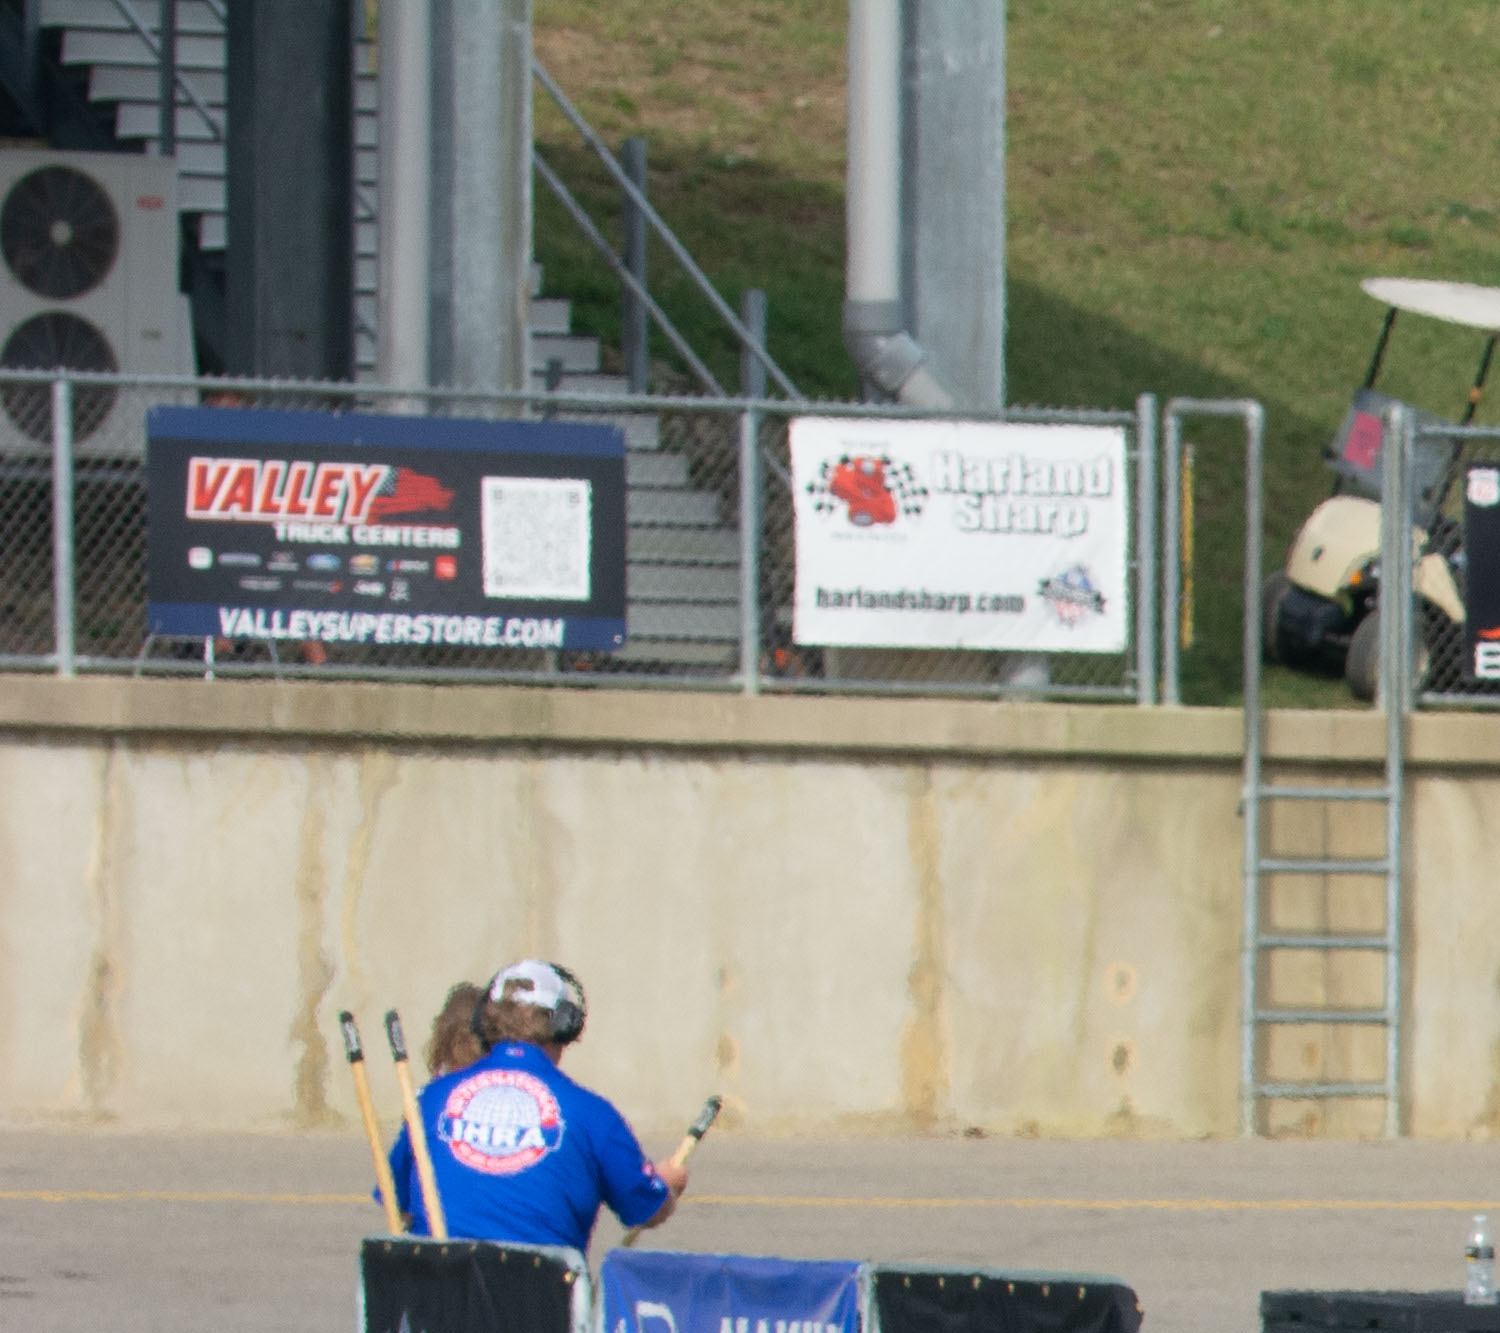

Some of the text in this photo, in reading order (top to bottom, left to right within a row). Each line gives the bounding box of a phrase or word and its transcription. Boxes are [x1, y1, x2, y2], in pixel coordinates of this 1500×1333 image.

[186, 457, 391, 524] VALLEY
[273, 521, 462, 548] TRUCK CENTERS
[816, 586, 1027, 614] harlandsharp.com
[218, 606, 564, 649] VALLEYSUPERSTORE.COM
[452, 1118, 546, 1148] IHRA
